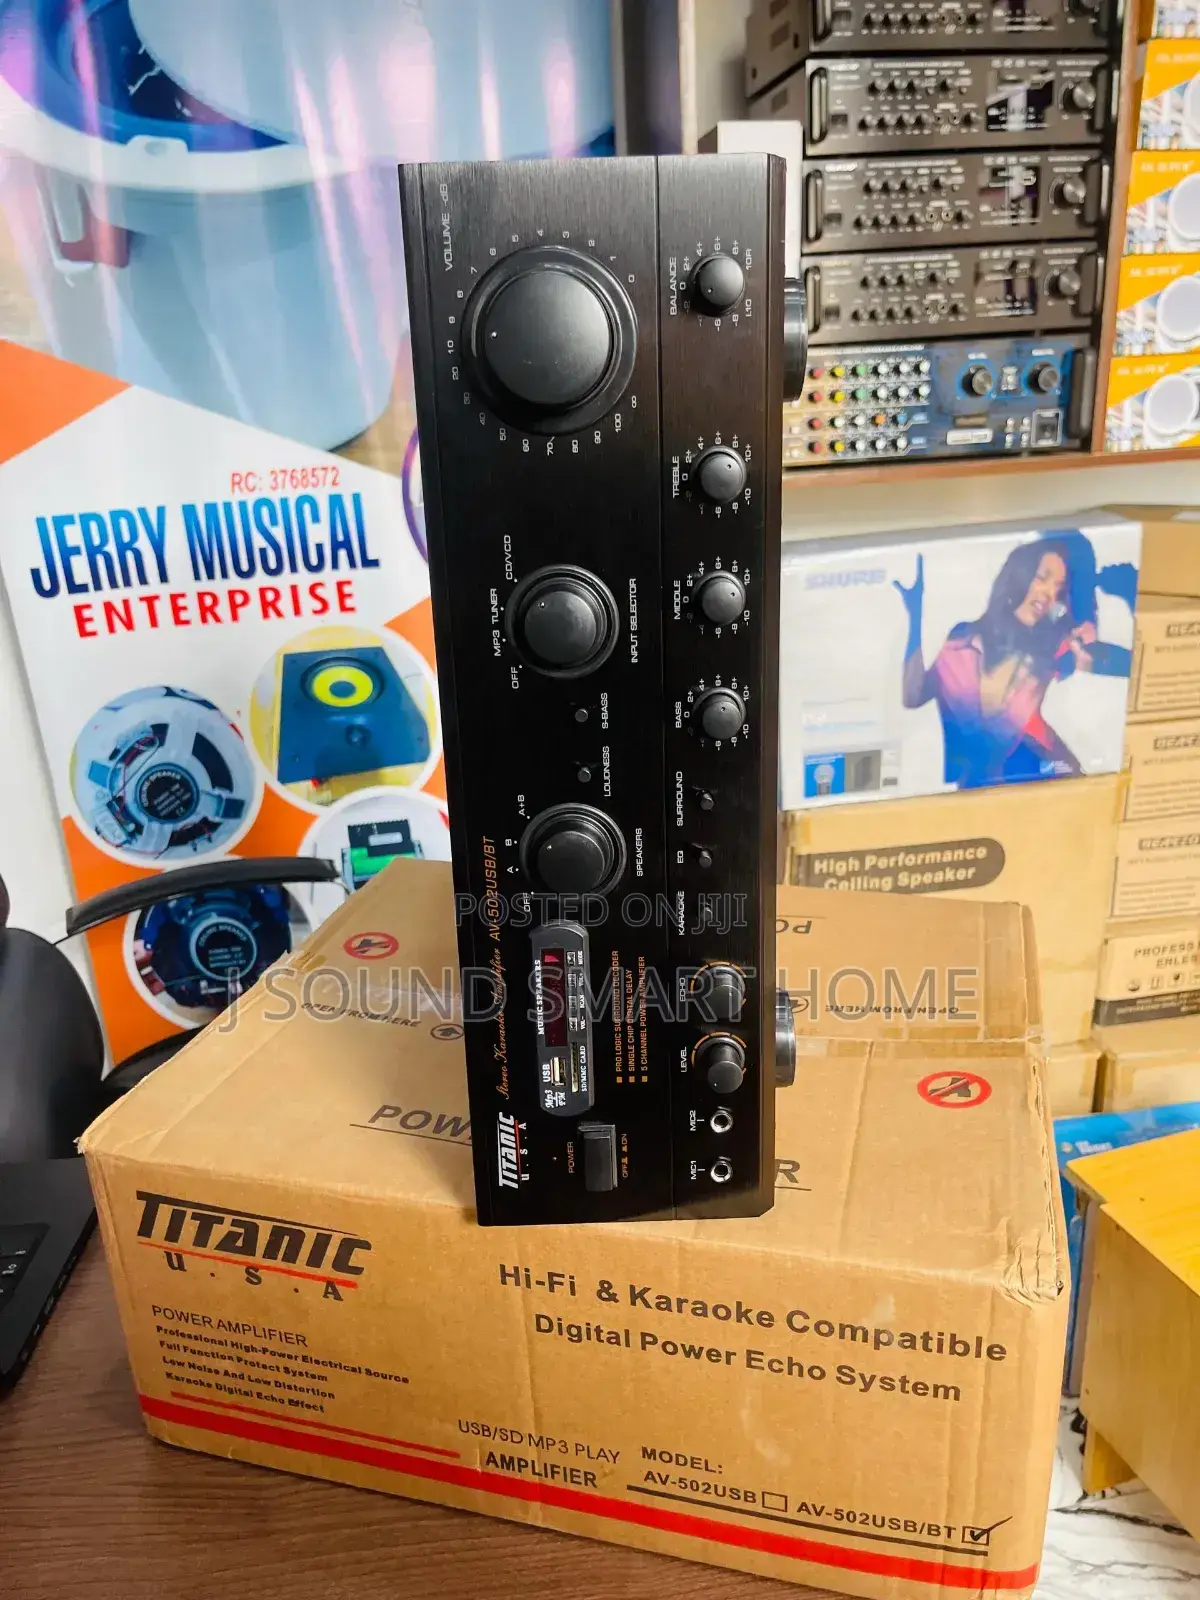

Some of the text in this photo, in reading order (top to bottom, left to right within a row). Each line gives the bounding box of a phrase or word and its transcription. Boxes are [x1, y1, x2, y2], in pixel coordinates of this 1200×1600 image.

[440, 212, 454, 271] VOLUME
[511, 234, 519, 243] 5
[536, 229, 544, 237] 4
[562, 230, 570, 239] 3
[588, 239, 596, 247] 2
[470, 266, 478, 275] 7
[683, 255, 691, 272] 2+
[669, 257, 678, 316] BALANCE
[679, 281, 686, 290] 0
[447, 339, 455, 354] 10
[451, 366, 460, 381] 20
[498, 427, 507, 442] 50
[613, 413, 622, 434] 100
[521, 438, 530, 453] 60
[545, 442, 554, 457] 70
[571, 439, 580, 454] 80
[593, 430, 602, 445] 90
[685, 449, 693, 464] 2+
[744, 443, 752, 463] 10+
[230, 465, 341, 495] RC: 3768572
[672, 455, 680, 499] TREBLE
[681, 472, 688, 481] 0
[744, 488, 752, 506] -10
[29, 492, 381, 600] JERRY MUSICAL
[503, 534, 513, 580] CD/VCD
[686, 573, 694, 588] 2+
[743, 567, 751, 586] 10+
[72, 579, 358, 640] ENTERPRISE
[490, 588, 499, 625] TUNER
[673, 579, 682, 621] MIDDLE
[682, 595, 690, 604] 0
[629, 577, 639, 664] INPUT SELECTOR
[743, 609, 751, 627] -10
[492, 629, 502, 657] MP3
[511, 666, 520, 690] OFF
[687, 690, 695, 704] 2+
[742, 684, 750, 703] 10+
[600, 692, 609, 730] S-BASS
[683, 710, 691, 719] 0
[742, 723, 750, 740] -10
[602, 745, 612, 798] LOUDNESS
[517, 794, 526, 817] A+B
[675, 770, 684, 827] SURROUND
[504, 838, 513, 847] B
[635, 827, 644, 878] SPEAKERS
[506, 866, 515, 874] A
[677, 850, 685, 864] EQ
[813, 845, 990, 877] High Performance
[482, 836, 501, 942] AV-502USB/BT
[896, 865, 977, 889] Speaker
[522, 892, 532, 913] OFF
[677, 890, 686, 937] KARAOKE
[637, 957, 646, 997] AMPLIFIER
[679, 976, 687, 1002] ECHO
[533, 959, 545, 1035] MUSIC SPEAKERS
[490, 948, 511, 1101] Stereo Karaoke Amplifier
[611, 950, 623, 1072] PRO LOGIC SURROUND DECODER
[625, 969, 636, 1072] SINGLE CHIP DIGITAL DELAY
[638, 1000, 647, 1027] POWER
[639, 1029, 648, 1065] CHANNEL
[680, 1046, 688, 1073] LEVEL
[542, 1063, 552, 1083] USB
[368, 1104, 474, 1140] POW
[689, 1109, 697, 1132] MIC2
[497, 1111, 520, 1189] TITANIC
[567, 1141, 576, 1175] POWER
[690, 1159, 698, 1181] MIC1
[135, 1189, 373, 1277] TITANIC
[152, 1304, 309, 1349] POWER AMPLIFIER
[498, 1263, 1009, 1363] Hi-Fi & Karaoke Compatible
[156, 1324, 411, 1385] Professional High-Power Electrical Source
[159, 1339, 328, 1384] Full Function Protect System
[534, 1312, 963, 1403] Digital Power Echo System
[161, 1354, 336, 1400] Low Noise And Low Distortion
[164, 1371, 325, 1414] Karaoke Digital Echo Effect
[457, 1417, 622, 1466] USB/SD MP3 PLAY
[484, 1450, 598, 1490] AMPLIFIER
[640, 1445, 725, 1477] MODEL:
[643, 1469, 958, 1541] AV-502USB AV-502USB/BT
